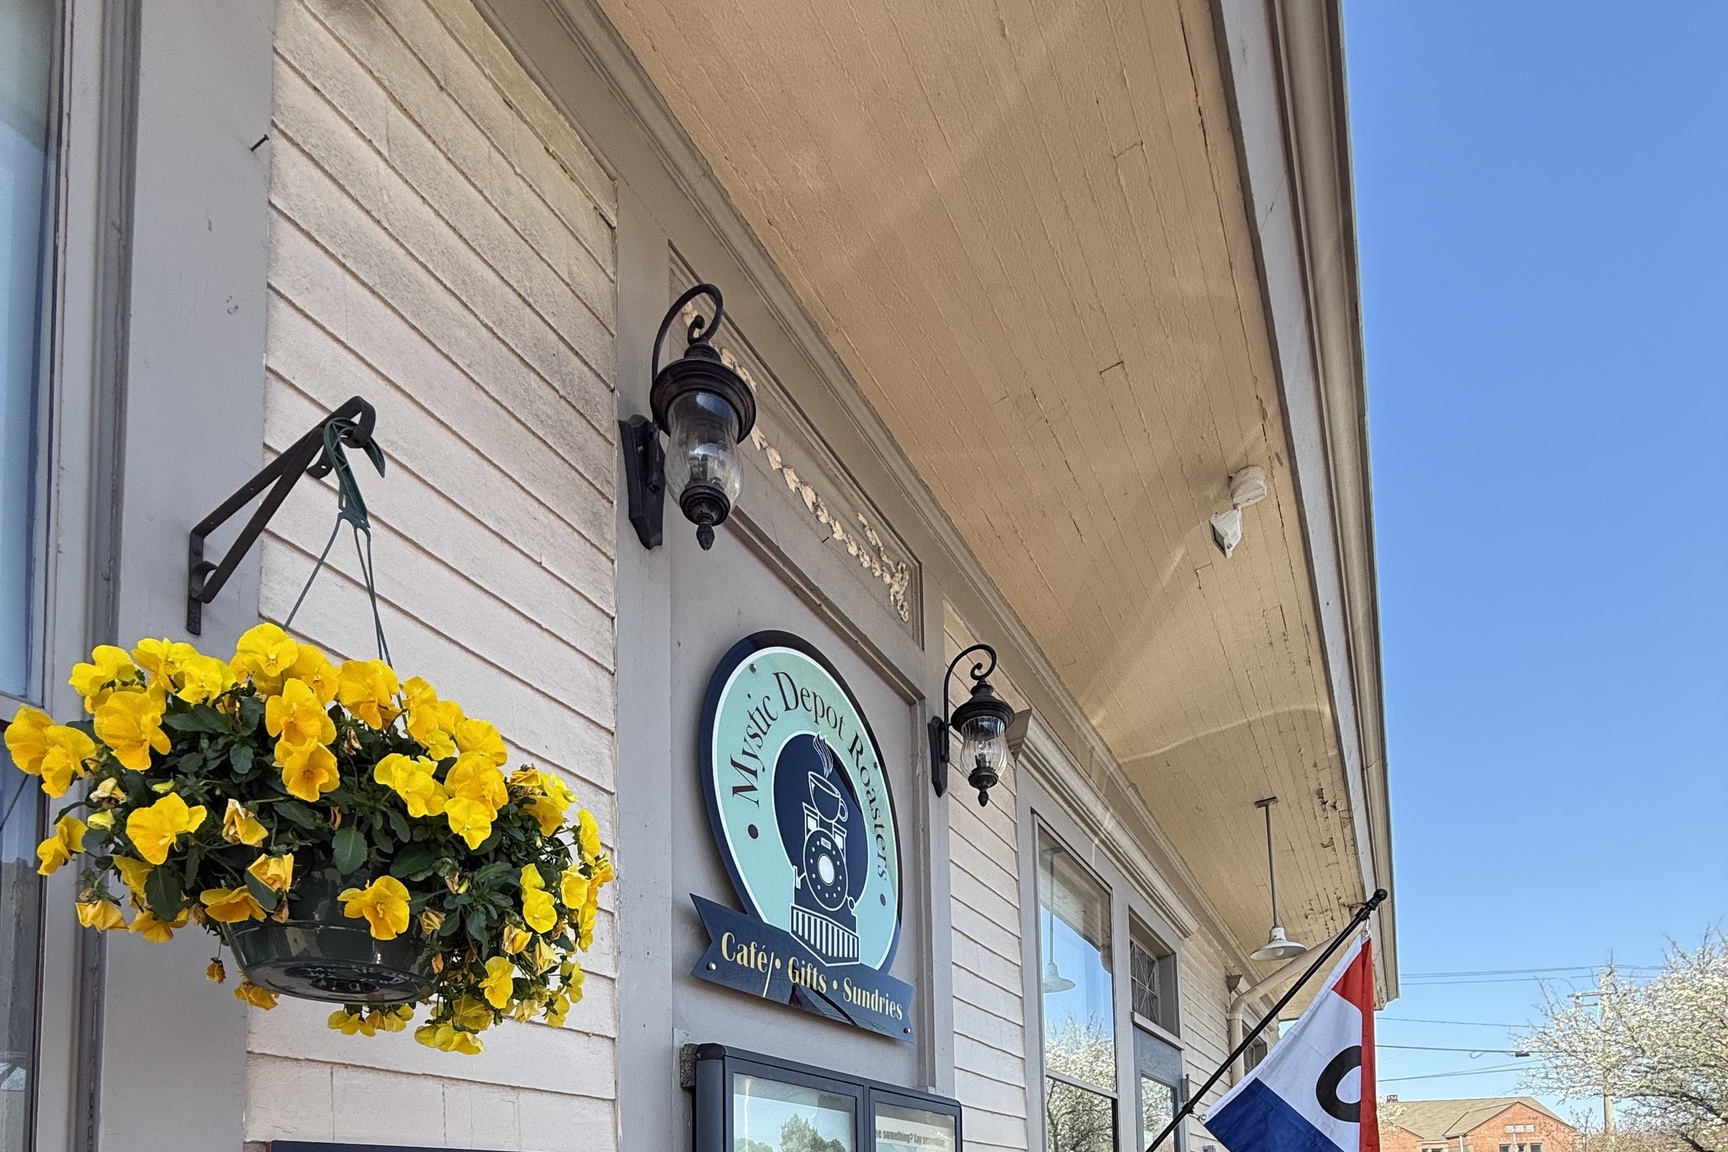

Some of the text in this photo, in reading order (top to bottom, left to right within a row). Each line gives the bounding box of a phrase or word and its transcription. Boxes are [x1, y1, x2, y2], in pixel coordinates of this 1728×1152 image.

[730, 671, 888, 882] Mystic Depot Roasters
[721, 931, 903, 1020] Café Gifts Sundries
